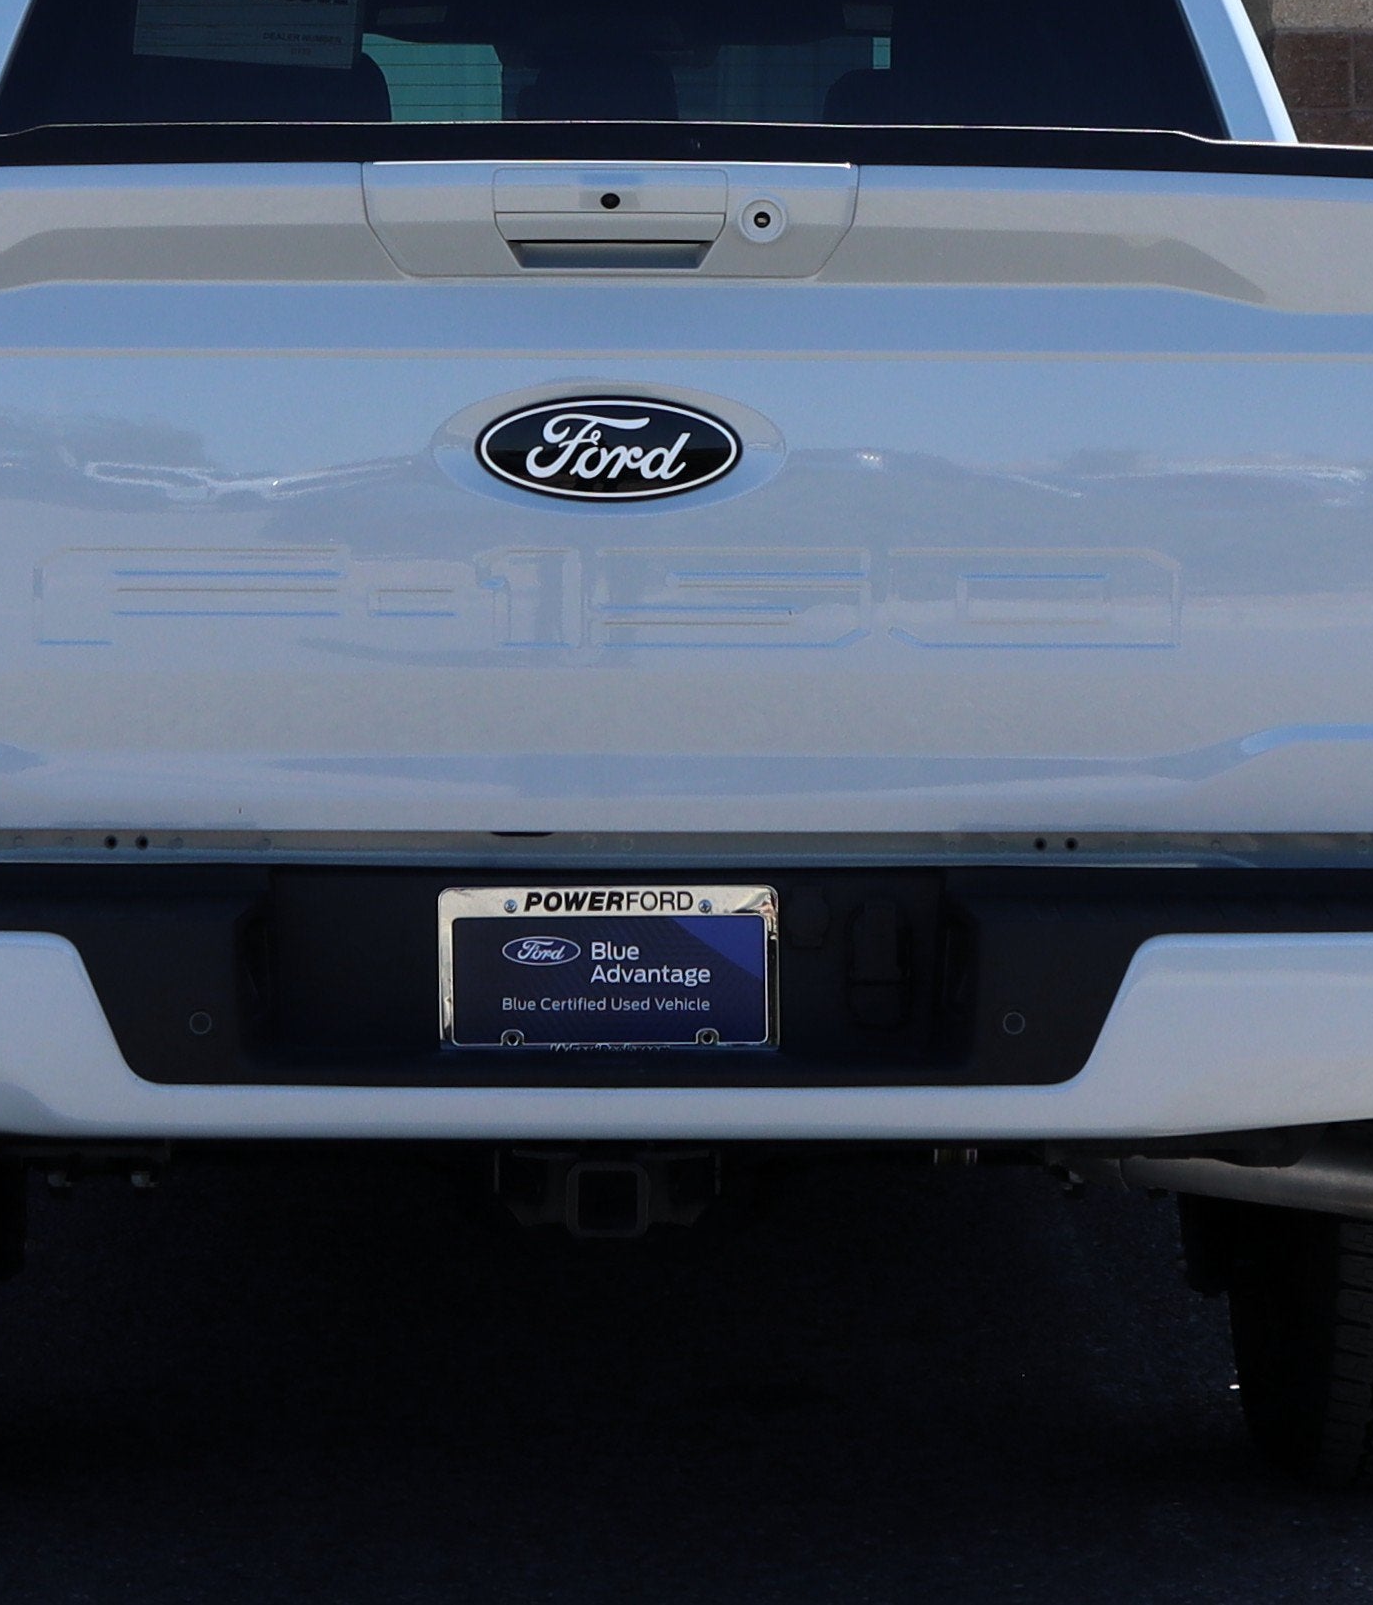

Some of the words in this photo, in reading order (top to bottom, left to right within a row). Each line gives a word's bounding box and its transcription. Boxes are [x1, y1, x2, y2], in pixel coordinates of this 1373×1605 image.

[527, 412, 688, 480] Ford
[524, 891, 694, 912] POWERFORD
[517, 940, 566, 961] Ford
[591, 941, 640, 961] Blue
[590, 964, 712, 987] Advantage
[502, 997, 537, 1012] Blue
[540, 996, 607, 1012] Certified
[610, 997, 651, 1012] Used
[654, 997, 711, 1012] Vehicle
